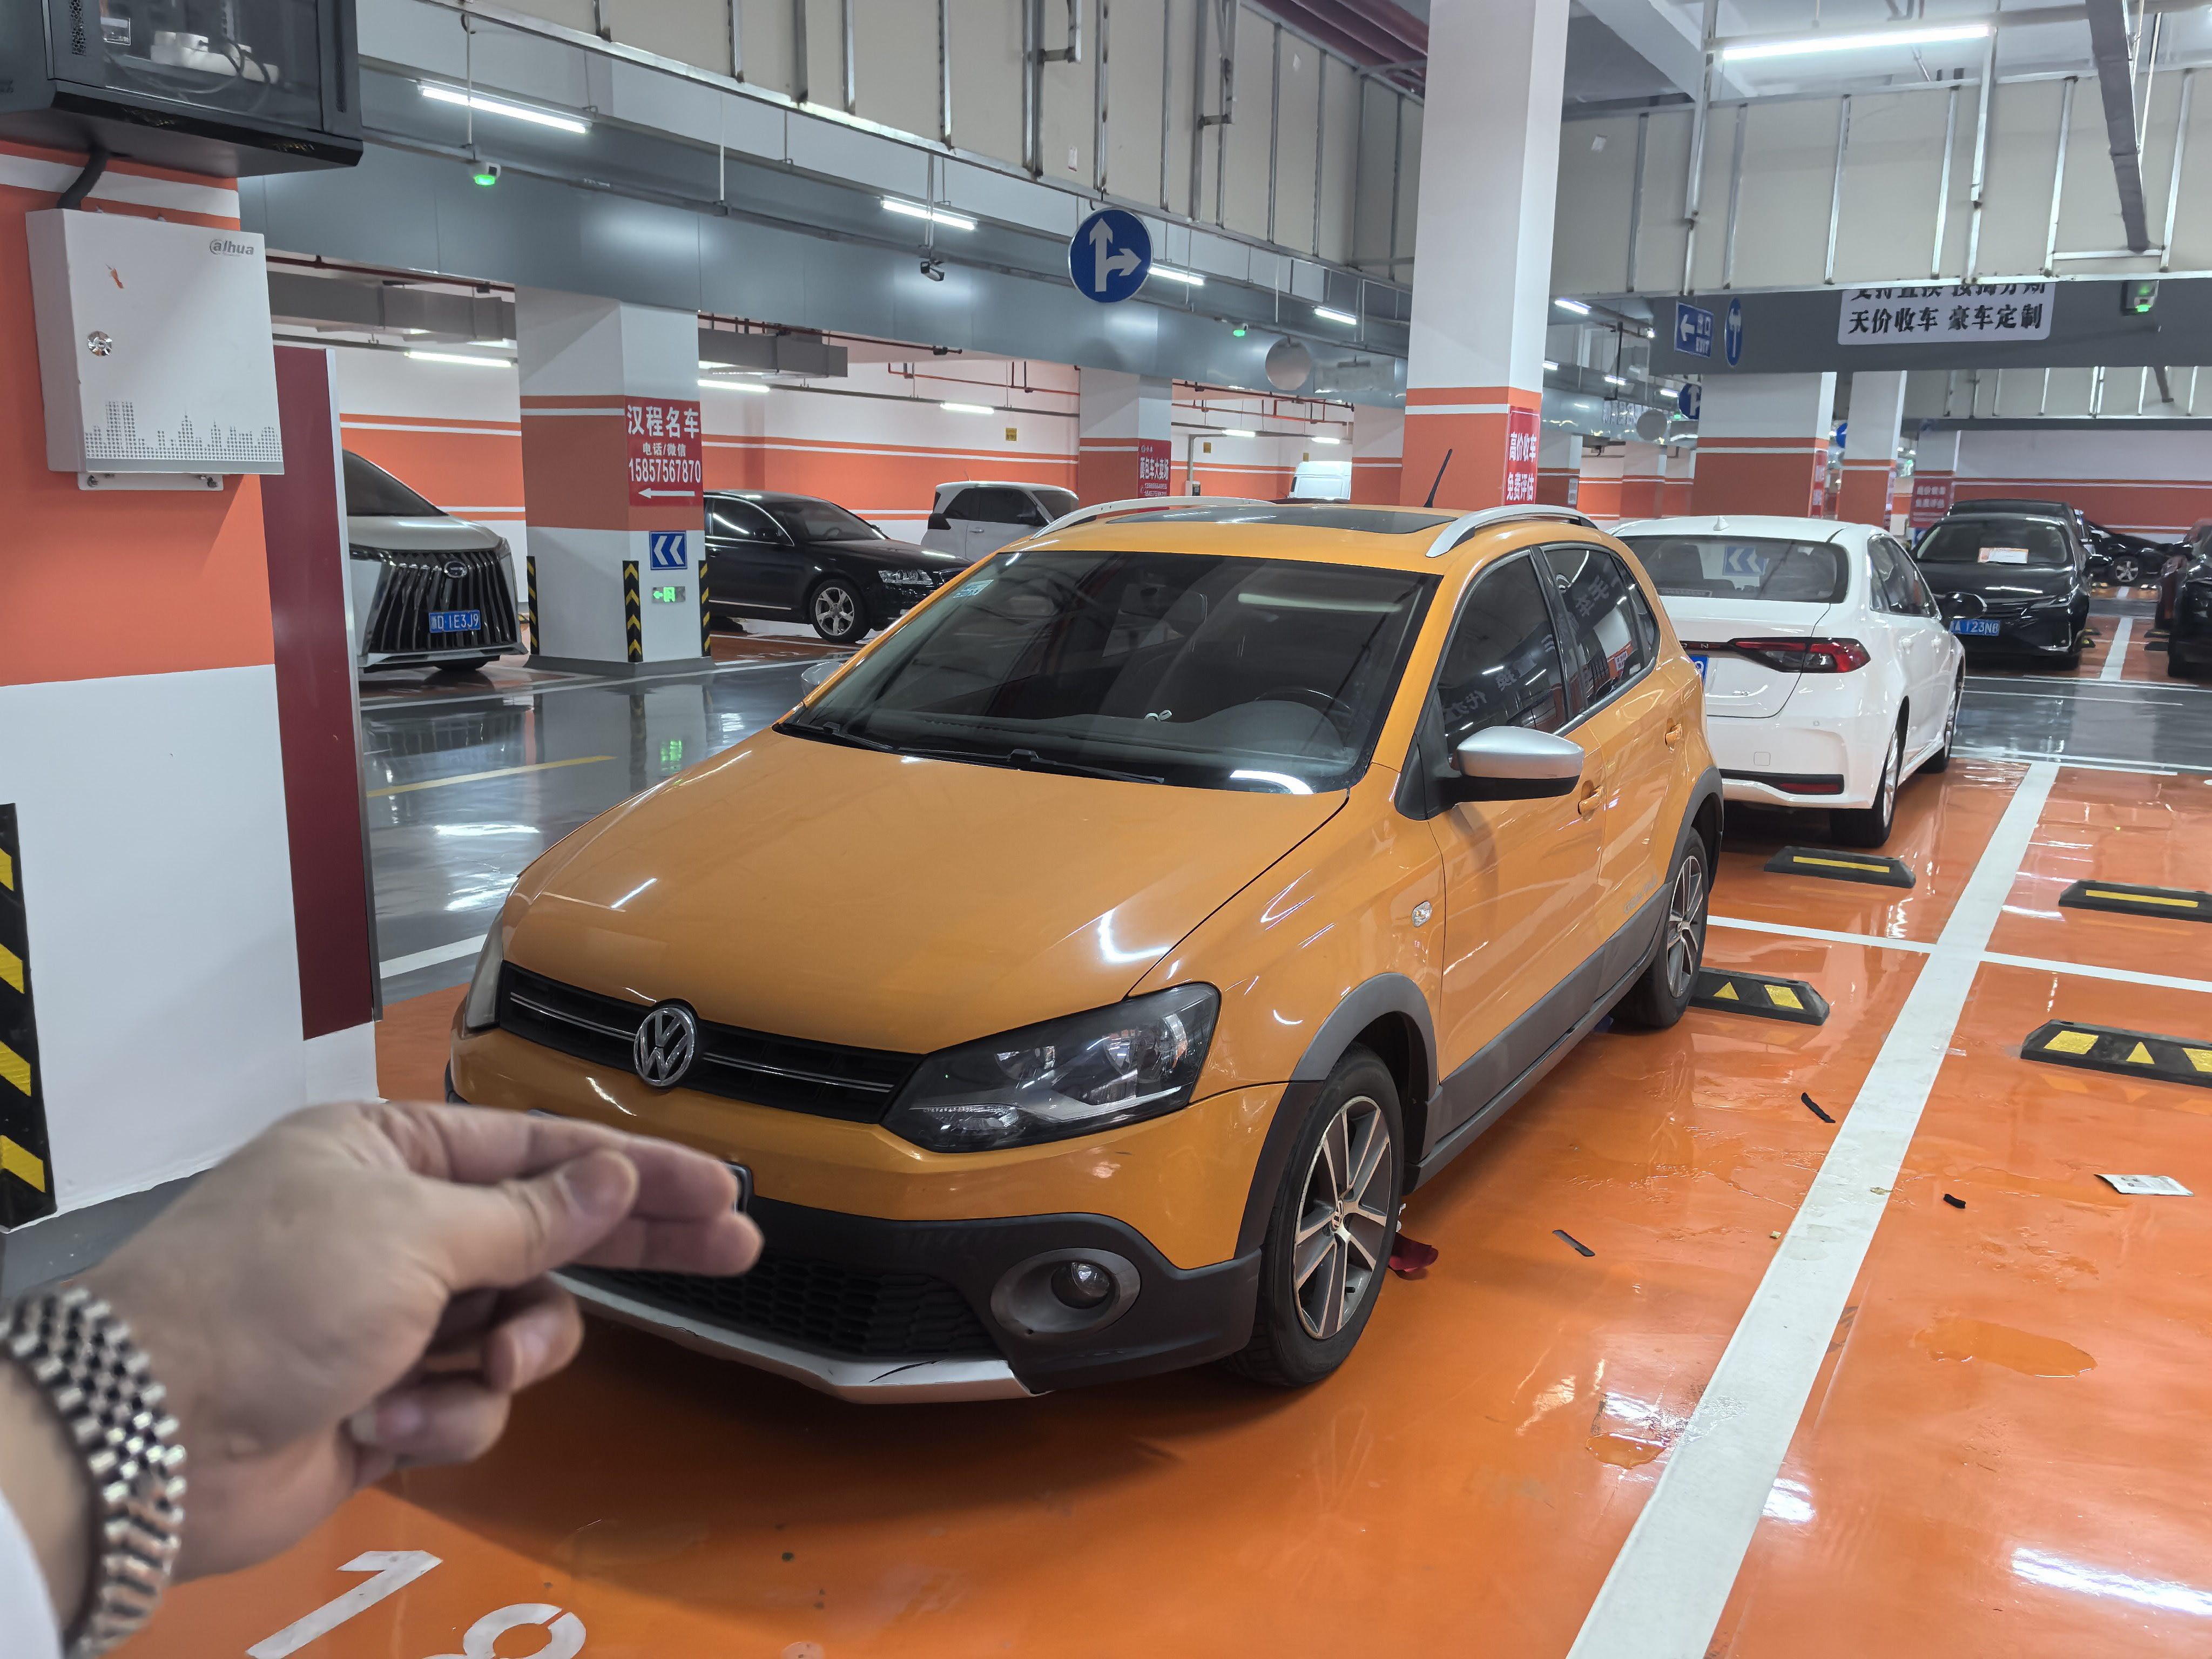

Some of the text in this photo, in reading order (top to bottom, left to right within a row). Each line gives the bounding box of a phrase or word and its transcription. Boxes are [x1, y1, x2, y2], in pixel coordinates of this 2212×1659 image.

[1848, 304, 2043, 334] 天价收车 豪车定制
[627, 404, 699, 439] 汉程名车
[643, 442, 686, 457] 电话/微信
[1509, 431, 1537, 463] 高价收车
[629, 458, 701, 483] 15857567870
[1506, 471, 1534, 501] 免费评估
